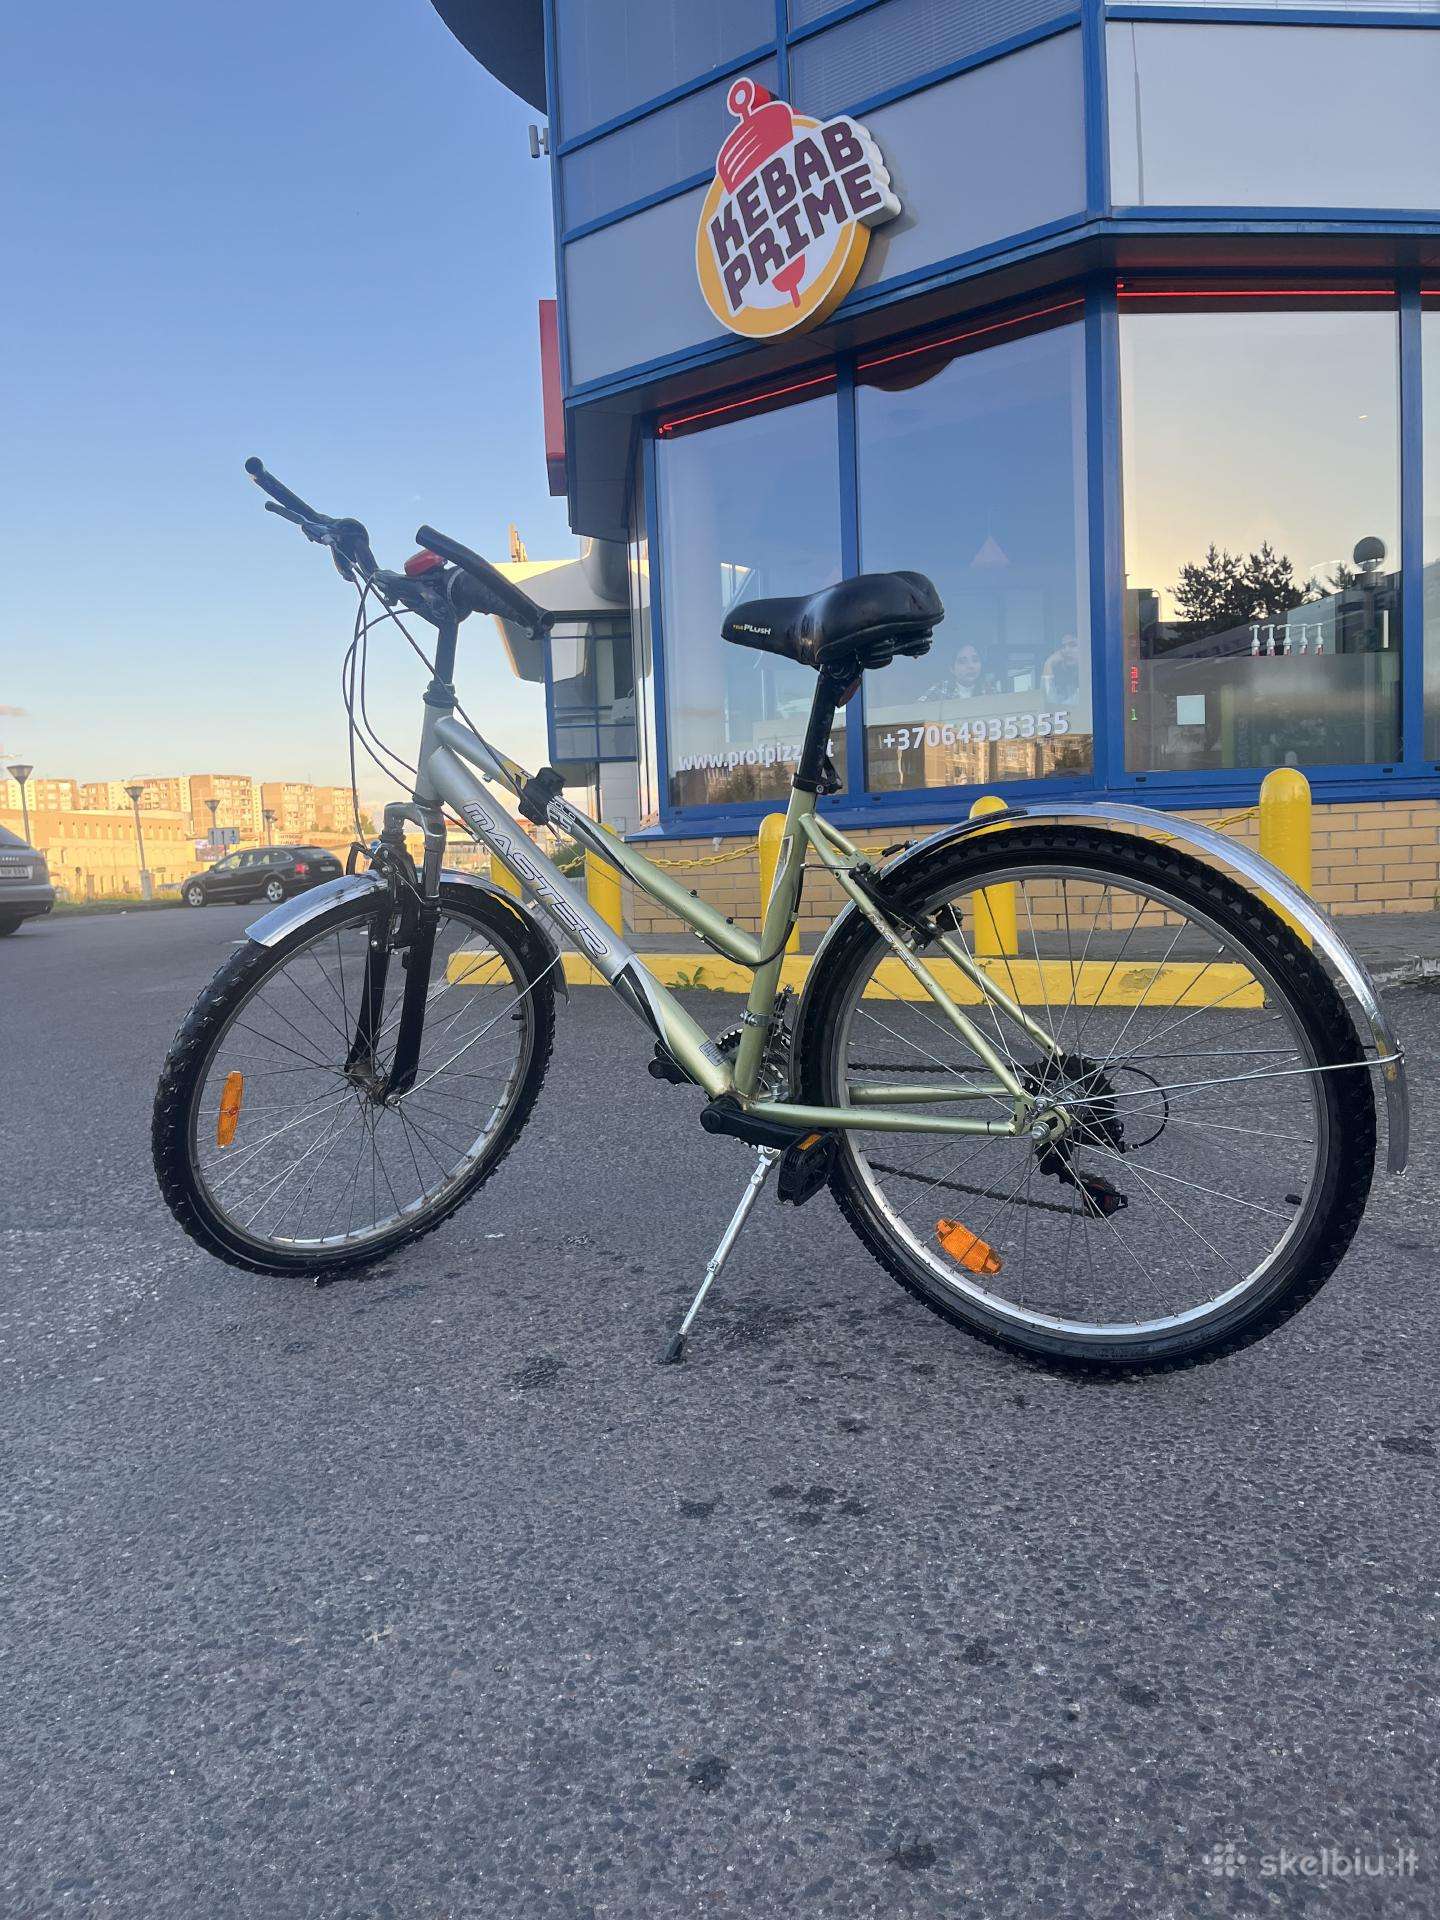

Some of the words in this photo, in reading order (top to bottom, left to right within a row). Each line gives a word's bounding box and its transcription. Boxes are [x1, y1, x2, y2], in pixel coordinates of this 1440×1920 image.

[711, 122, 864, 267] KEBAB
[724, 164, 881, 311] PRIME
[679, 739, 834, 771] www.profpizzt
[883, 711, 1069, 751] +37064935355
[462, 801, 608, 959] MASTER
